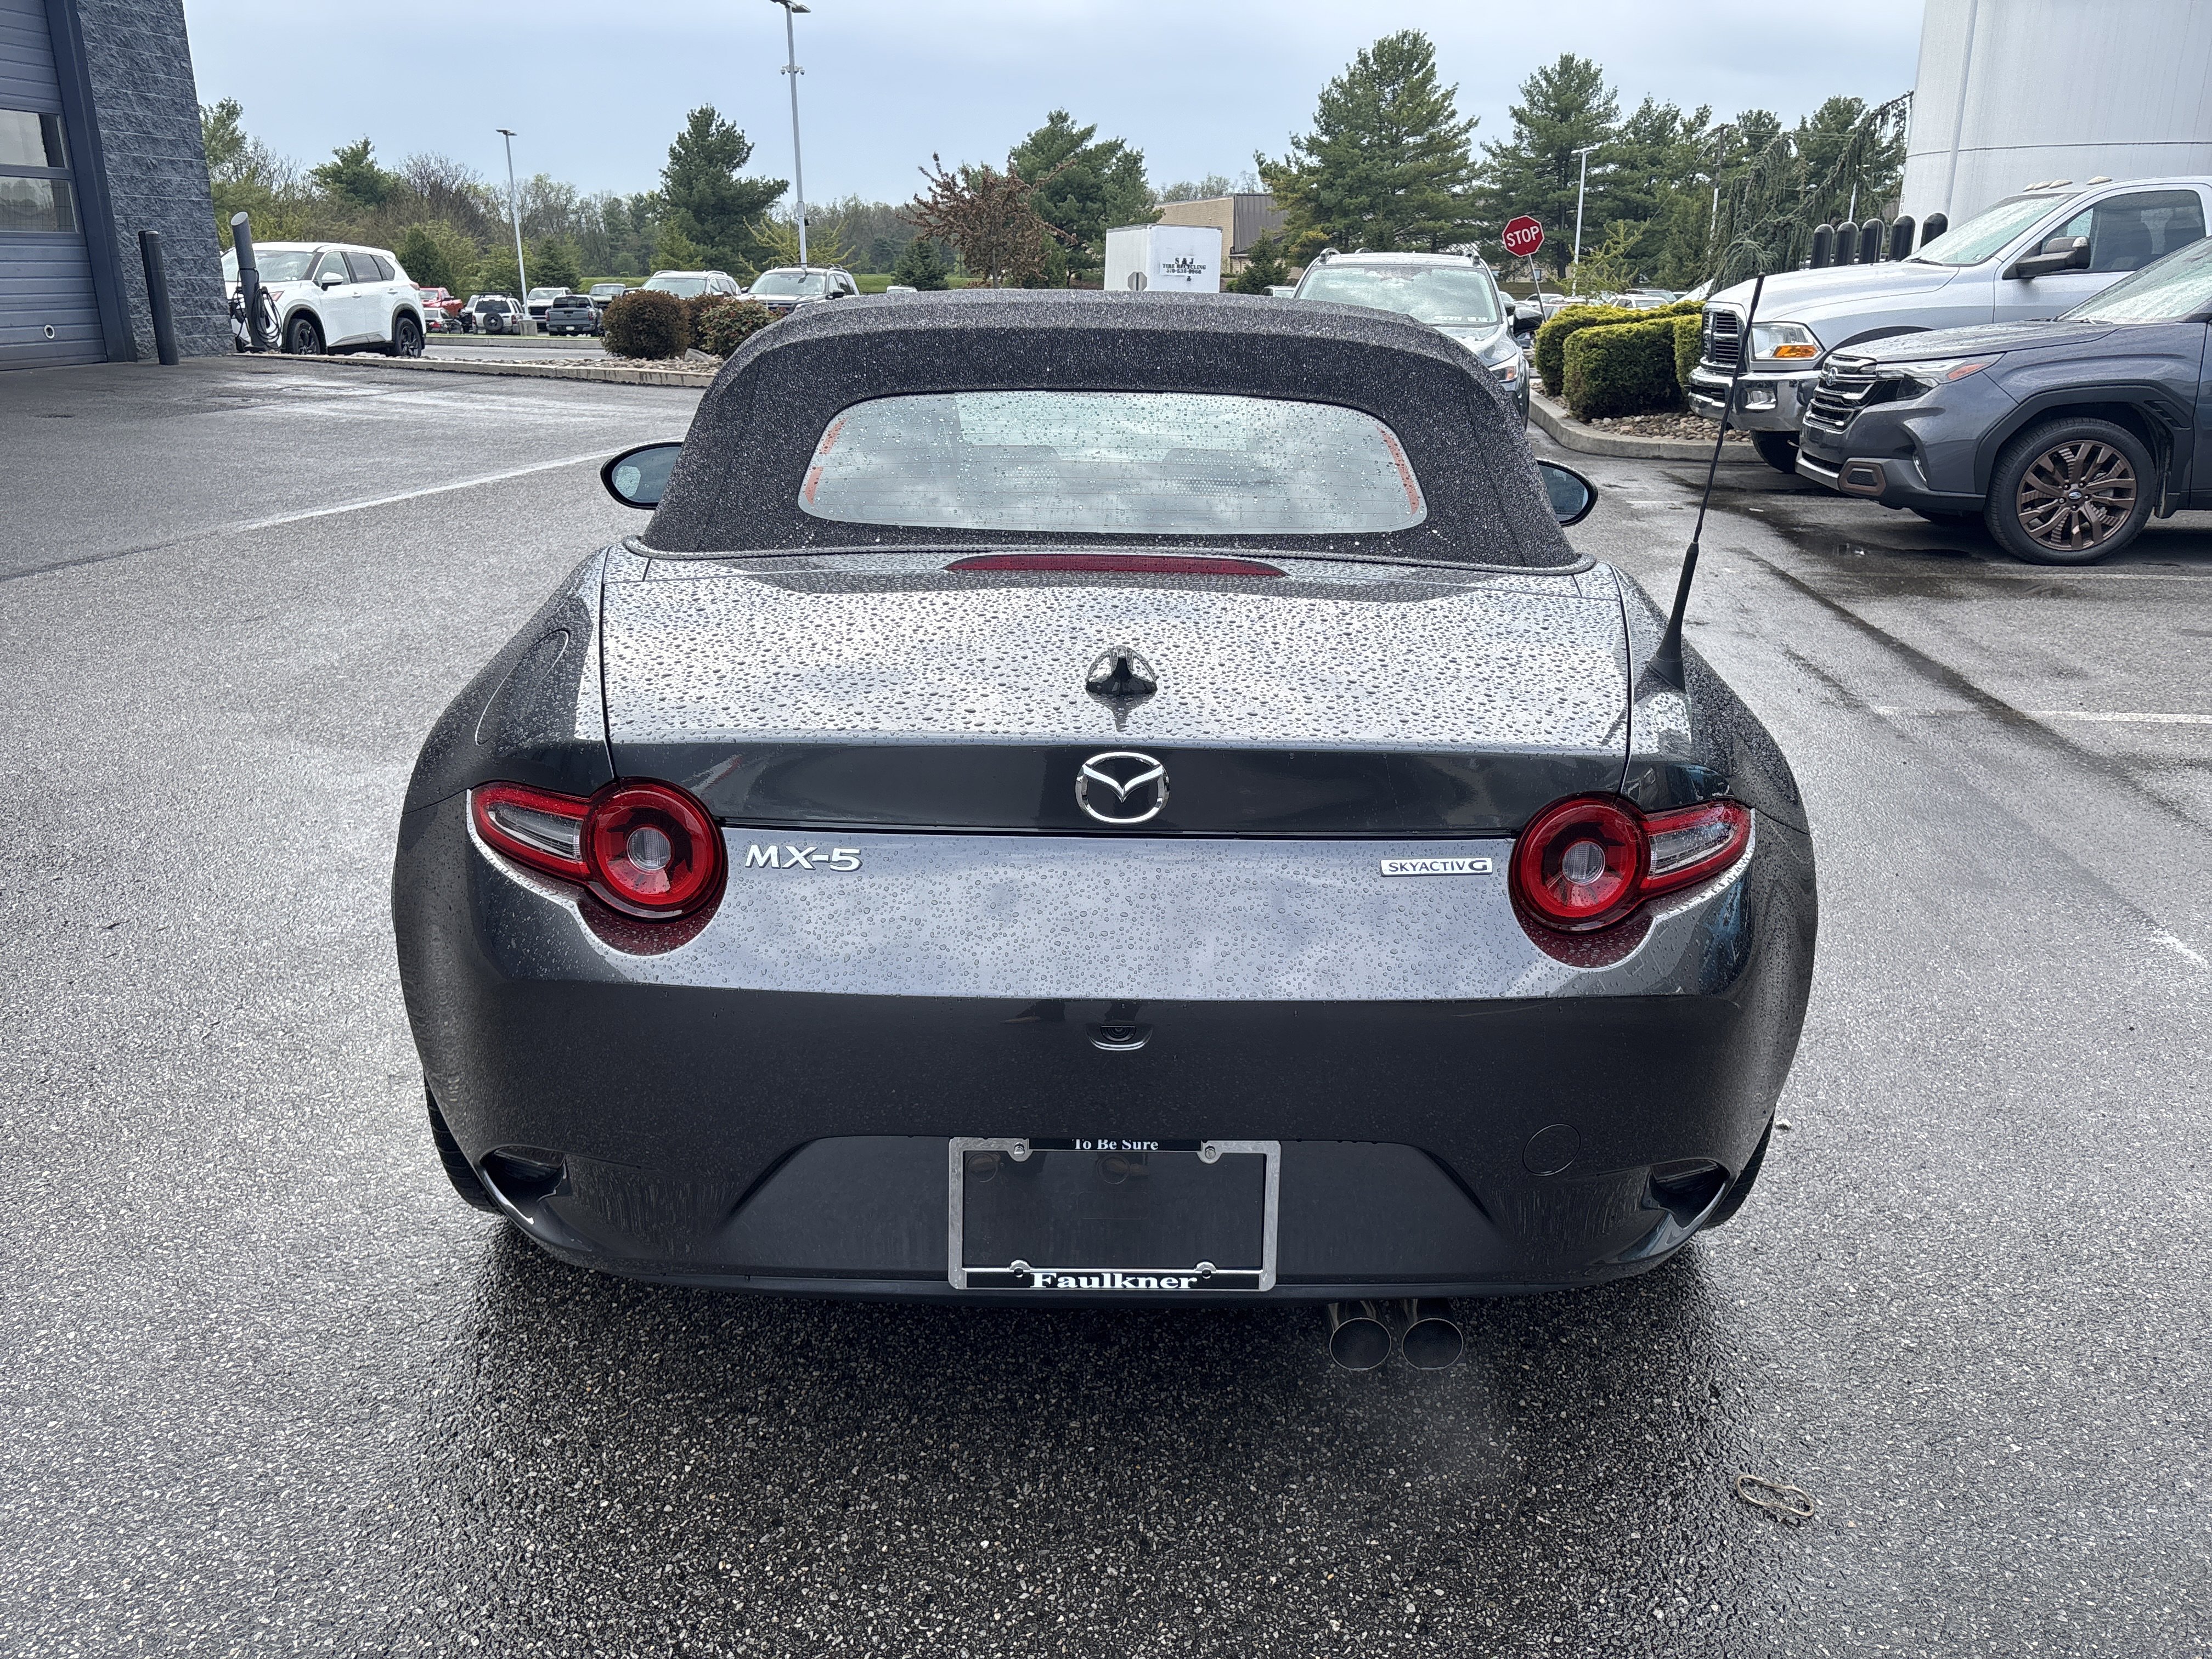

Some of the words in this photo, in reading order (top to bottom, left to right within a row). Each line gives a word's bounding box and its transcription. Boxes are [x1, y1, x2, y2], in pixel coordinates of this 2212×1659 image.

[1506, 226, 1539, 247] STOP
[744, 844, 863, 872] MX-5
[1071, 1138, 1092, 1149] To
[1097, 1139, 1117, 1150] Be
[1121, 1139, 1159, 1150] Sure
[1030, 1272, 1198, 1289] Faulkner
